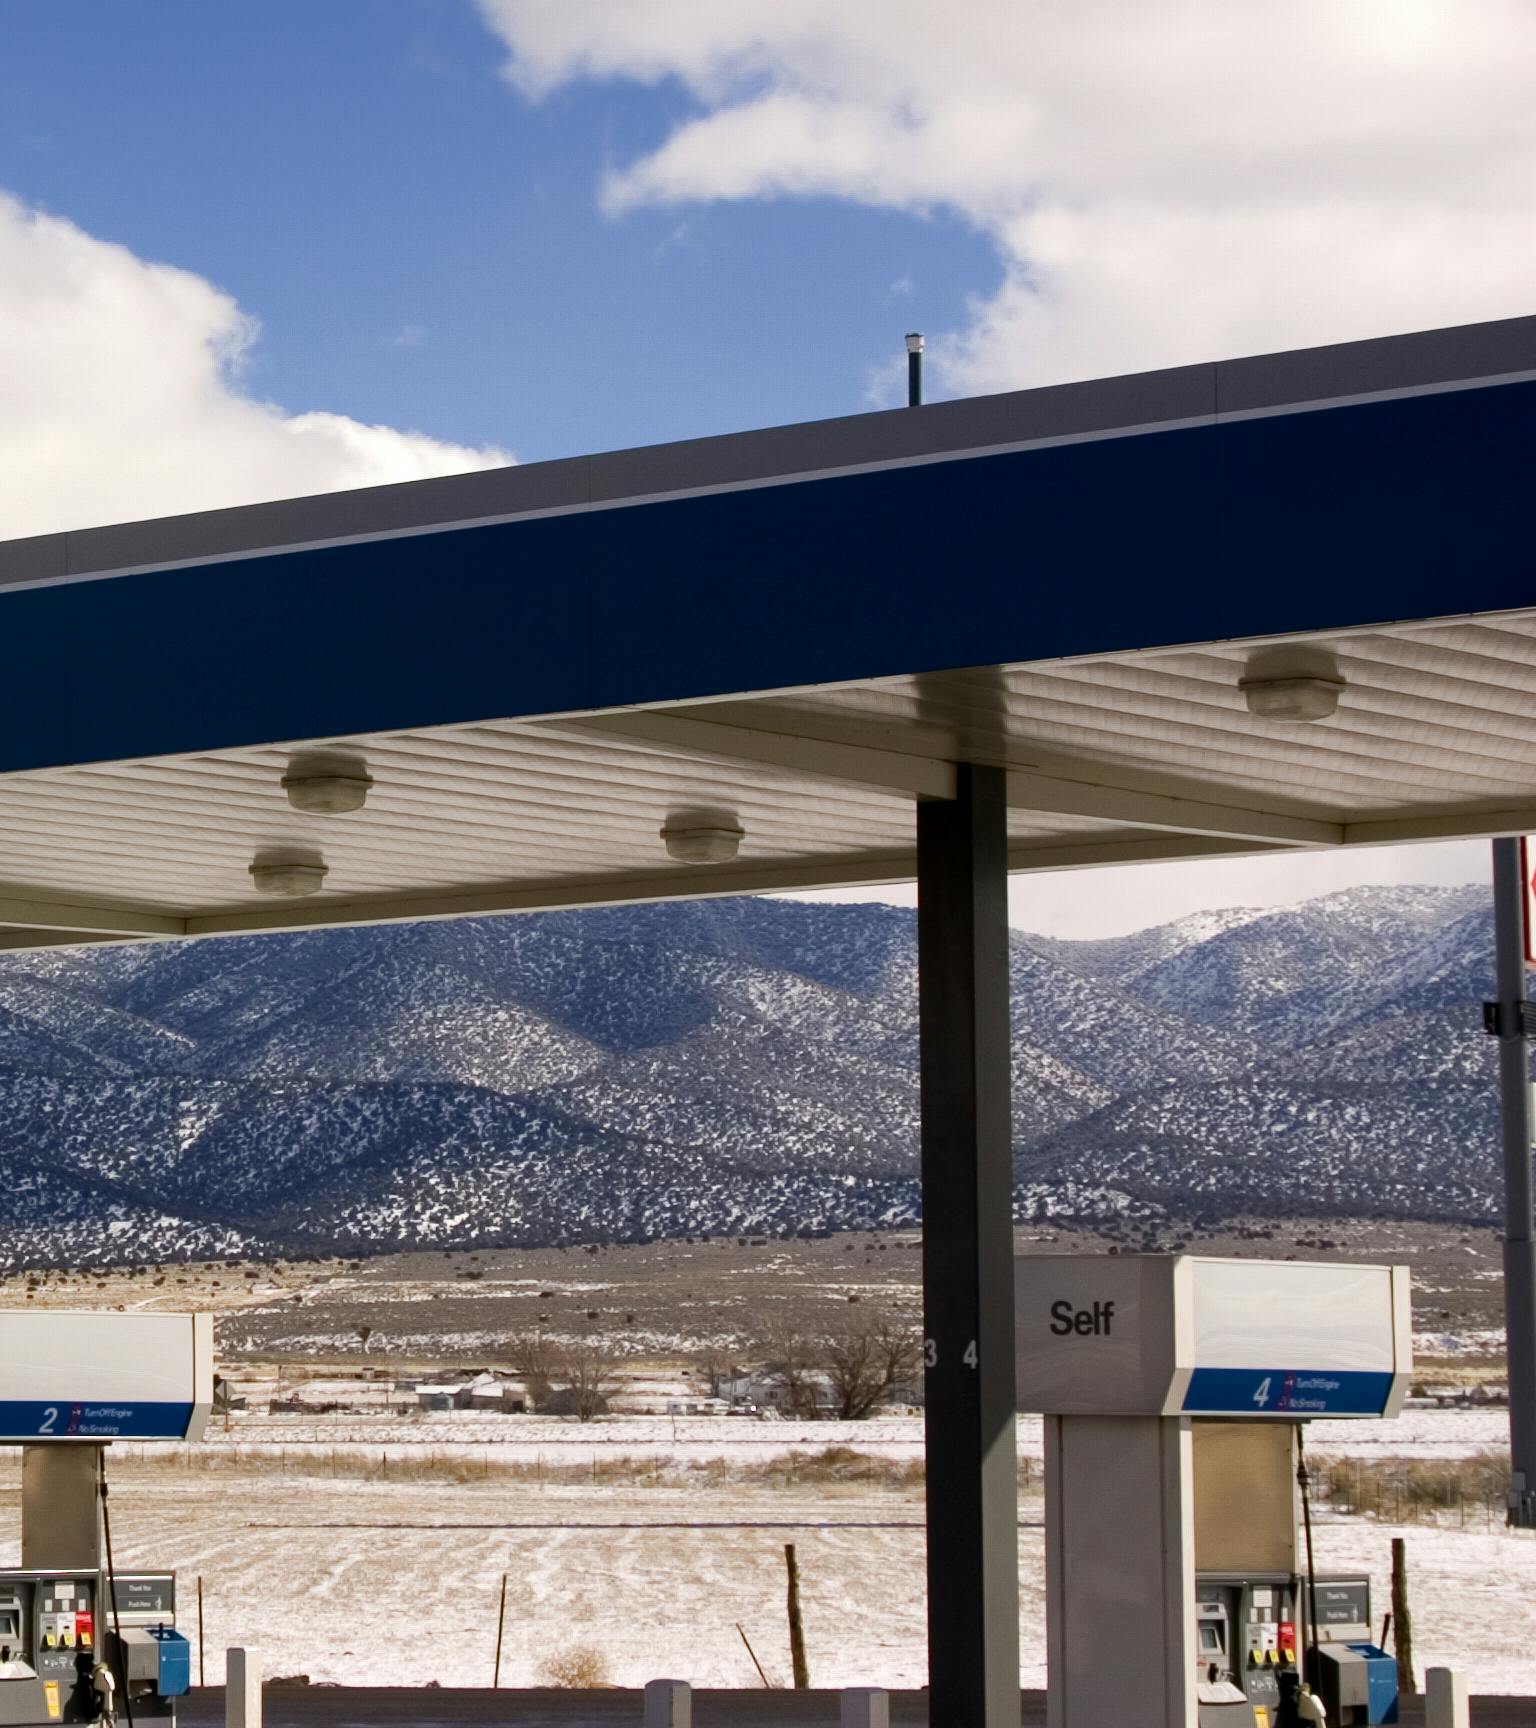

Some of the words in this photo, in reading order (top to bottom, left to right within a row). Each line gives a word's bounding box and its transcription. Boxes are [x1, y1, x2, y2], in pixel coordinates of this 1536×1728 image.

[1050, 1300, 1115, 1335] Self
[925, 1338, 937, 1367] 3
[963, 1340, 977, 1369] 4
[1253, 1377, 1271, 1407] 4
[38, 1407, 58, 1433] 2
[84, 1408, 100, 1417] Turn
[111, 1409, 133, 1418] Engine
[78, 1424, 88, 1433] No
[89, 1424, 119, 1435] Smoking
